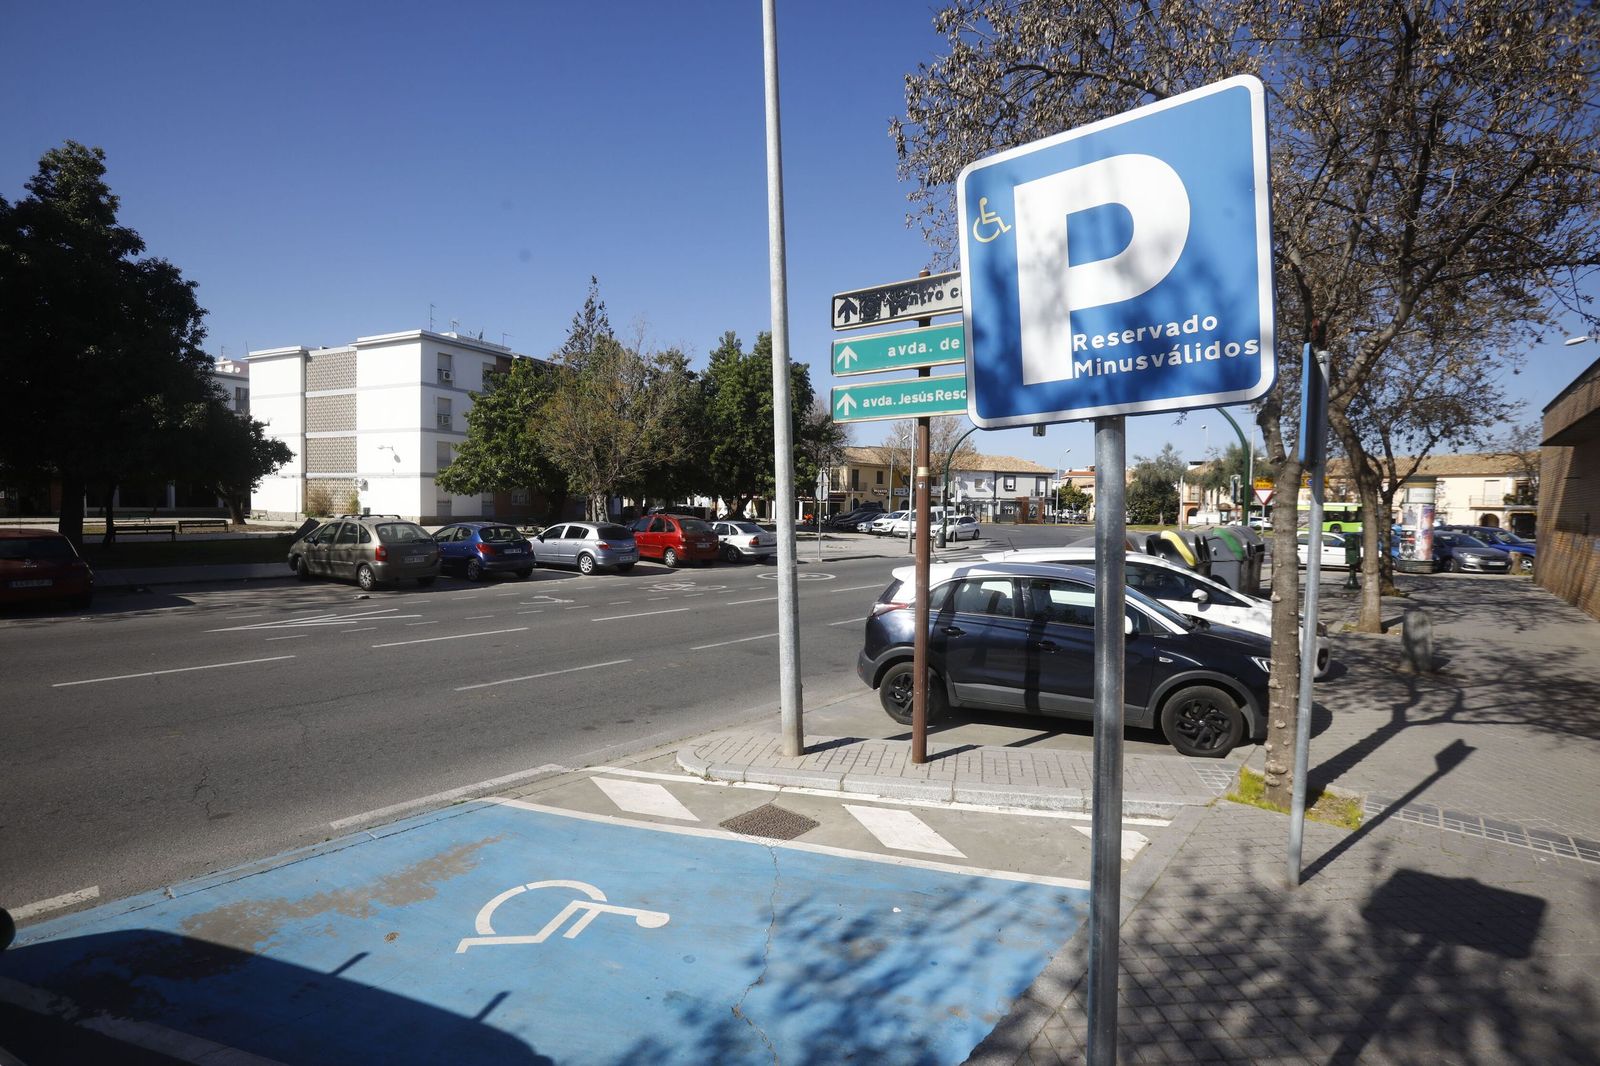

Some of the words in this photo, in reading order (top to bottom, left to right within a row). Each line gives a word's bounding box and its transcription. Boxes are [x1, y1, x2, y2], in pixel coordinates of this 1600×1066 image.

[1013, 153, 1191, 386] P
[888, 341, 933, 357] avda.
[940, 337, 960, 350] de
[1073, 314, 1218, 352] Reservado
[1073, 339, 1260, 379] Minusválidos
[863, 395, 897, 408] avda.
[898, 391, 934, 405] Jesús
